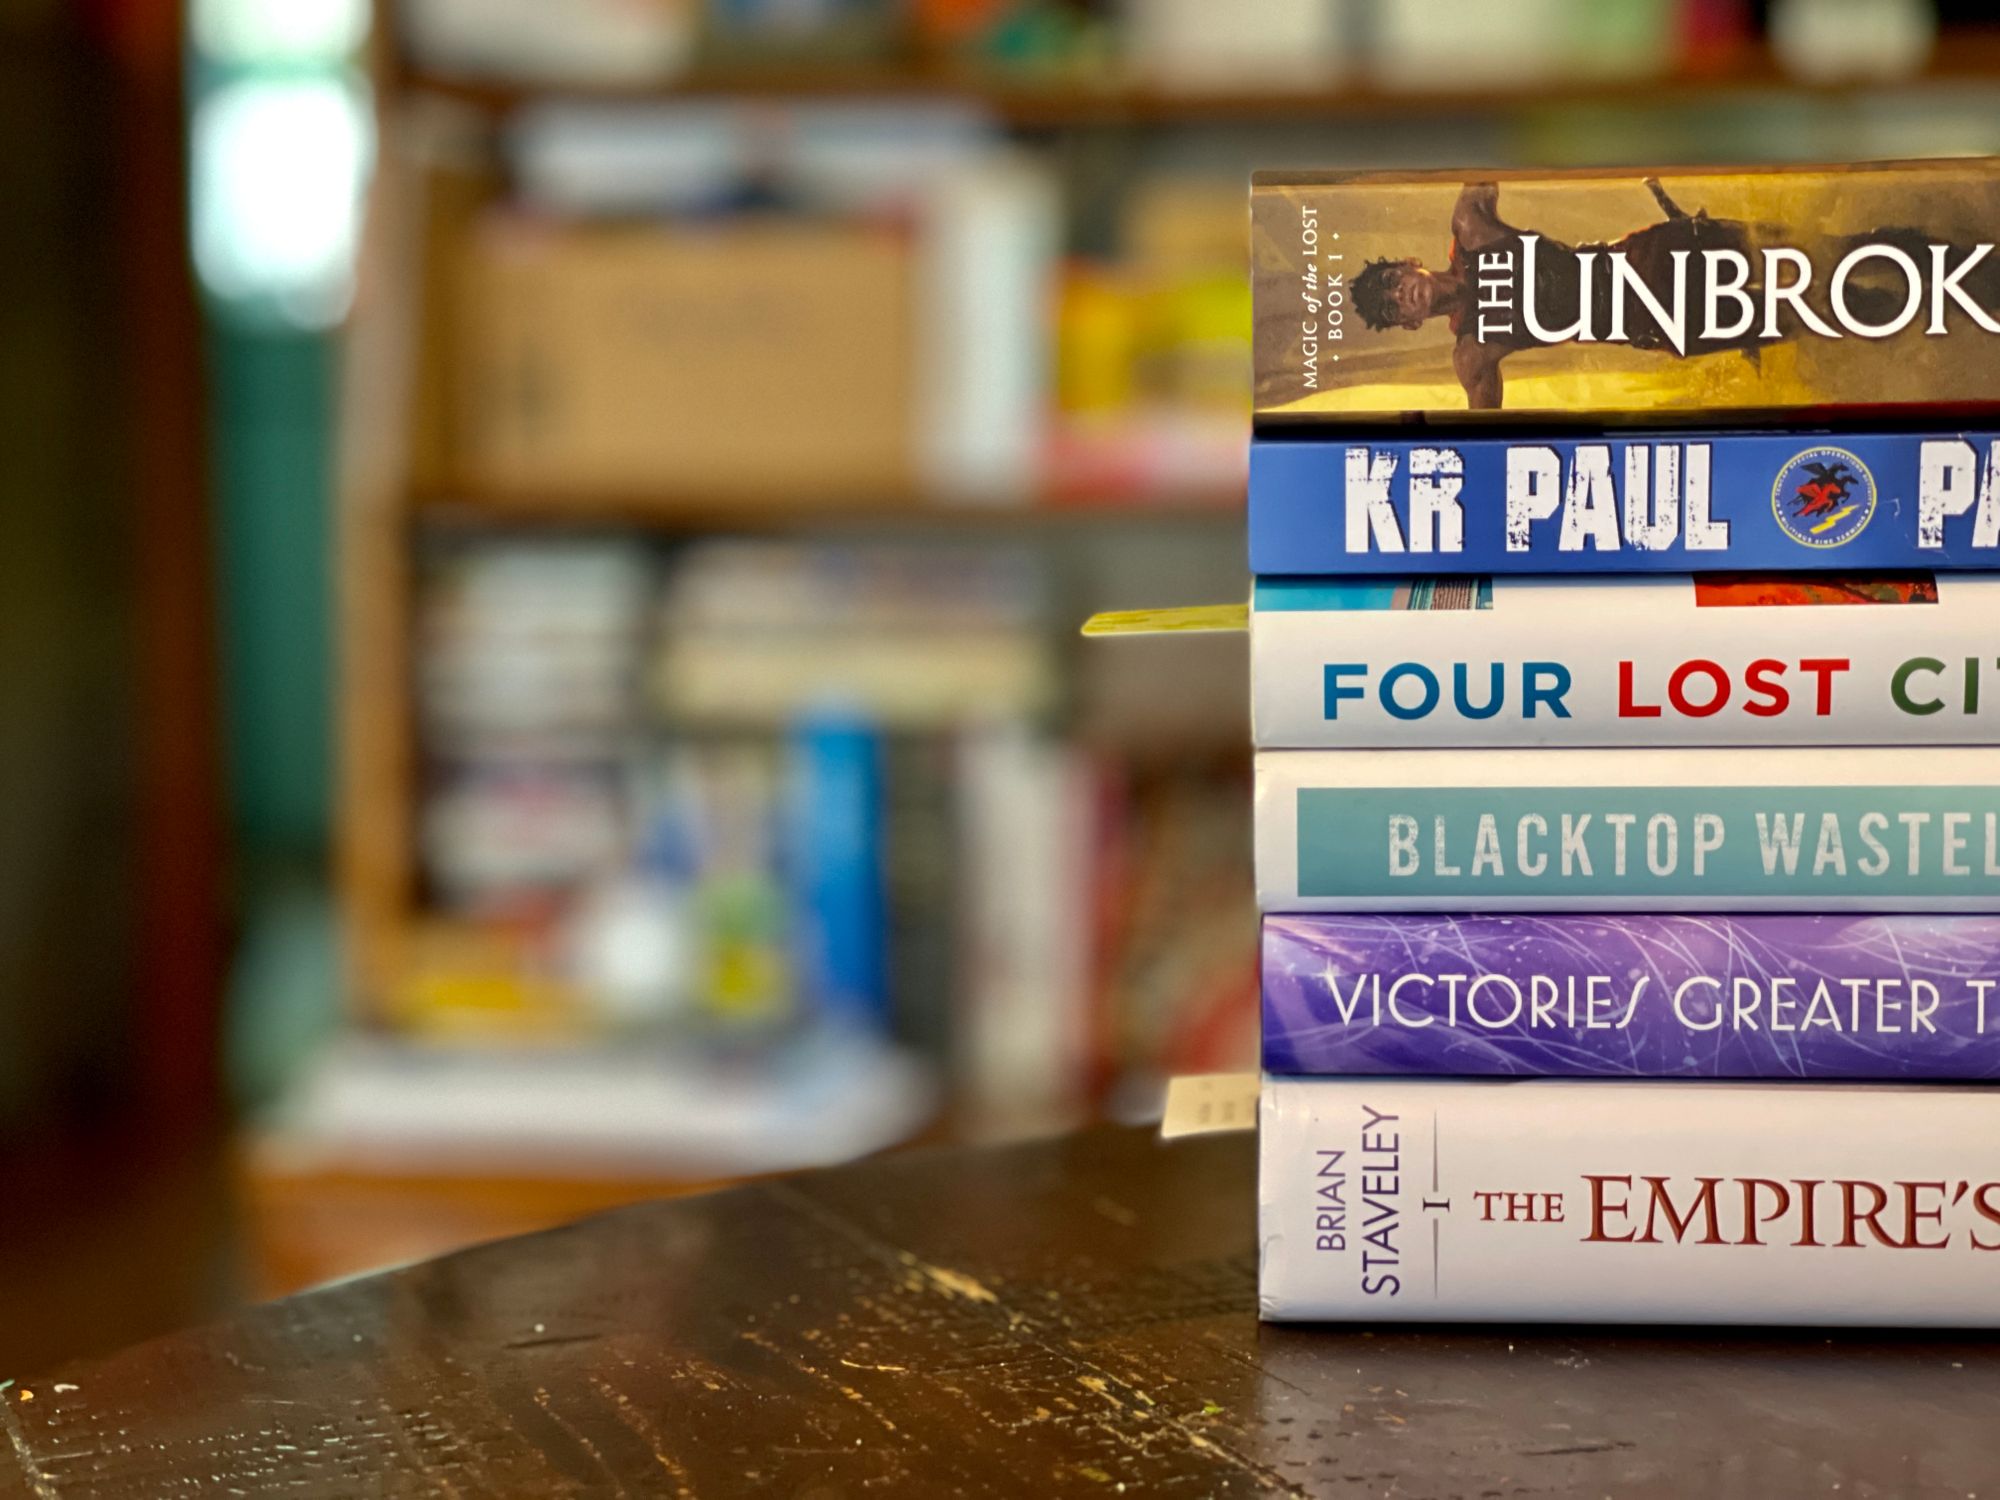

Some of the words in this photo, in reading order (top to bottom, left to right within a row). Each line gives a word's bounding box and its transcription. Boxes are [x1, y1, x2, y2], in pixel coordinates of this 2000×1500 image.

[1302, 205, 1318, 256] LOST
[1302, 263, 1319, 291] the
[1302, 291, 1323, 314] of
[1328, 273, 1343, 340] BOOK
[1478, 250, 1514, 344] THE
[1517, 235, 2000, 358] UNBROK
[1302, 321, 1318, 389] MAGIC
[1345, 446, 1465, 553] KR
[1506, 443, 1730, 552] PAUL
[1323, 662, 1572, 721] FOUR
[1618, 658, 1851, 719] LOST
[1890, 656, 2000, 717] CI
[1388, 812, 1726, 877] BLACKTOP
[1326, 972, 1650, 1030] VICTORIES
[1673, 976, 1940, 1035] GREATER
[1965, 980, 1997, 1034] T
[1316, 1150, 1346, 1251] BRIAN
[1361, 1104, 1400, 1297] STAVELEY
[1473, 1191, 1566, 1223] THE
